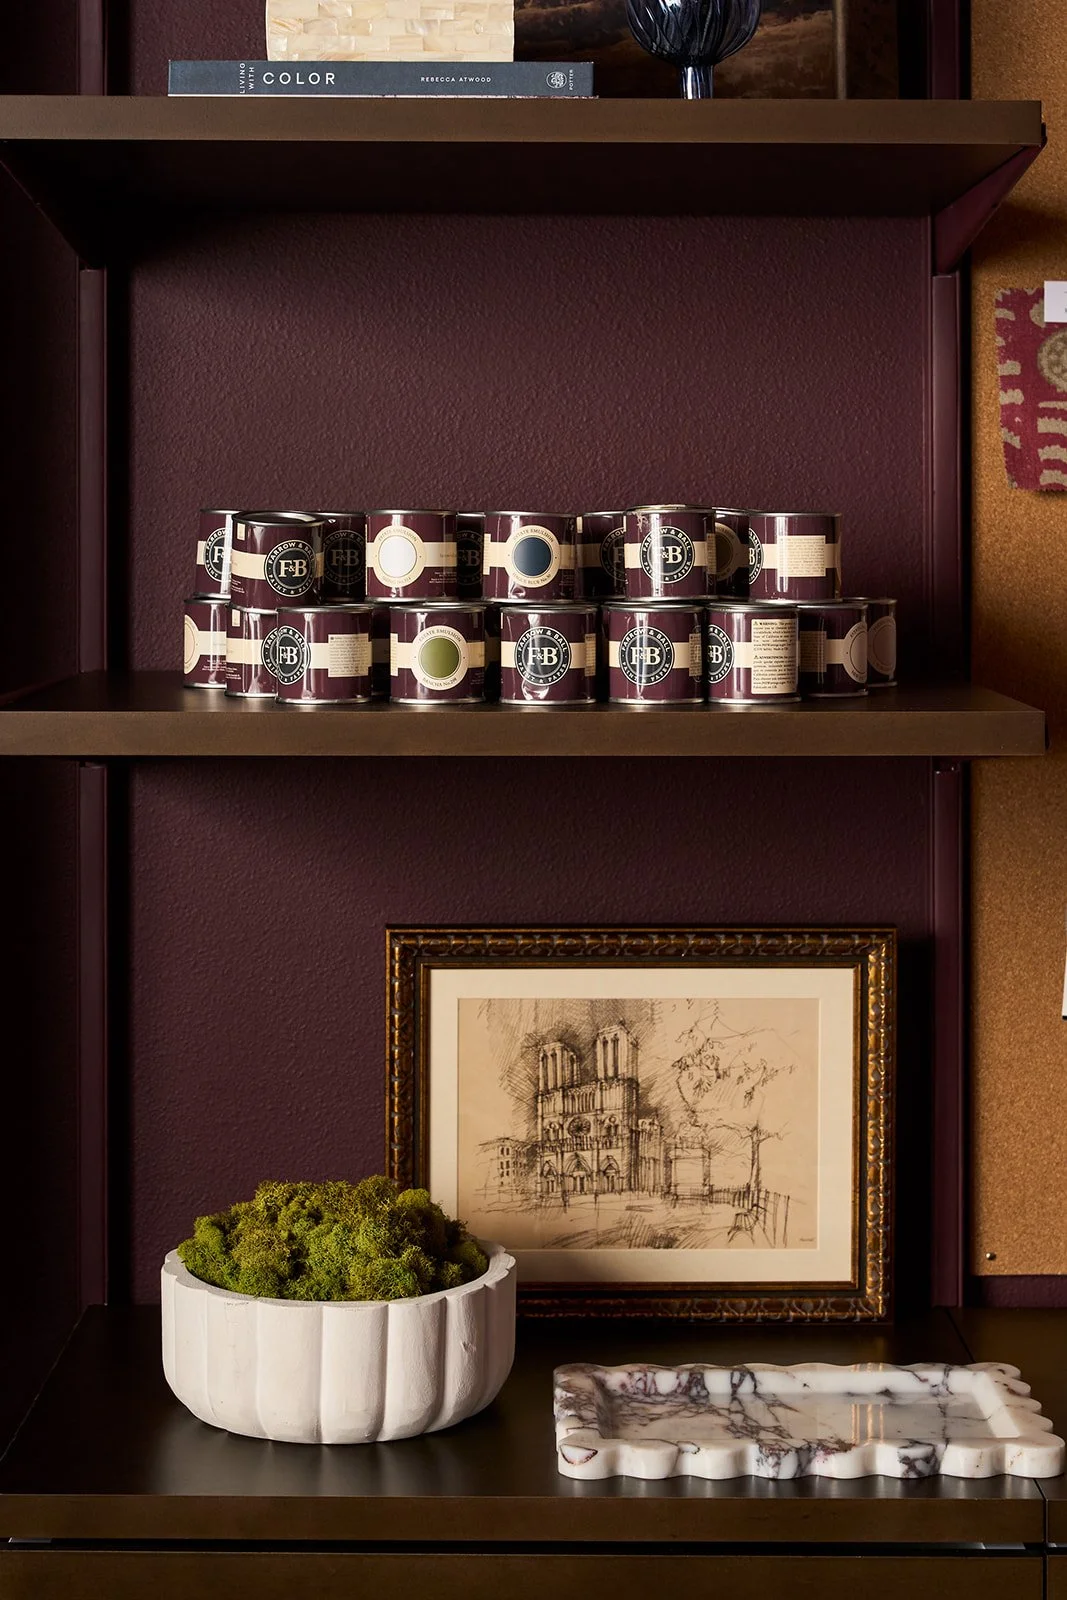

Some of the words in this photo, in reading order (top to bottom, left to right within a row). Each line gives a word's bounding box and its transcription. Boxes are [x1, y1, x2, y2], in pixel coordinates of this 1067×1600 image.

[262, 72, 336, 85] COLOR
[677, 532, 691, 551] BALL
[268, 541, 296, 564] FARROW
[278, 559, 308, 578] F&B
[673, 561, 691, 580] PAPER
[268, 575, 288, 593] PAINT
[518, 628, 544, 652] FARROW
[553, 633, 569, 652] BALL
[621, 628, 646, 651] FARROW
[656, 633, 672, 652] BALL
[719, 632, 731, 652] BALL
[278, 646, 300, 665] F&B
[526, 647, 559, 666] F&B
[630, 646, 661, 665] F&B
[518, 662, 536, 682] PAINT
[547, 663, 568, 682] PAPER
[650, 663, 671, 682] PAPER
[715, 662, 731, 680] PAPER
